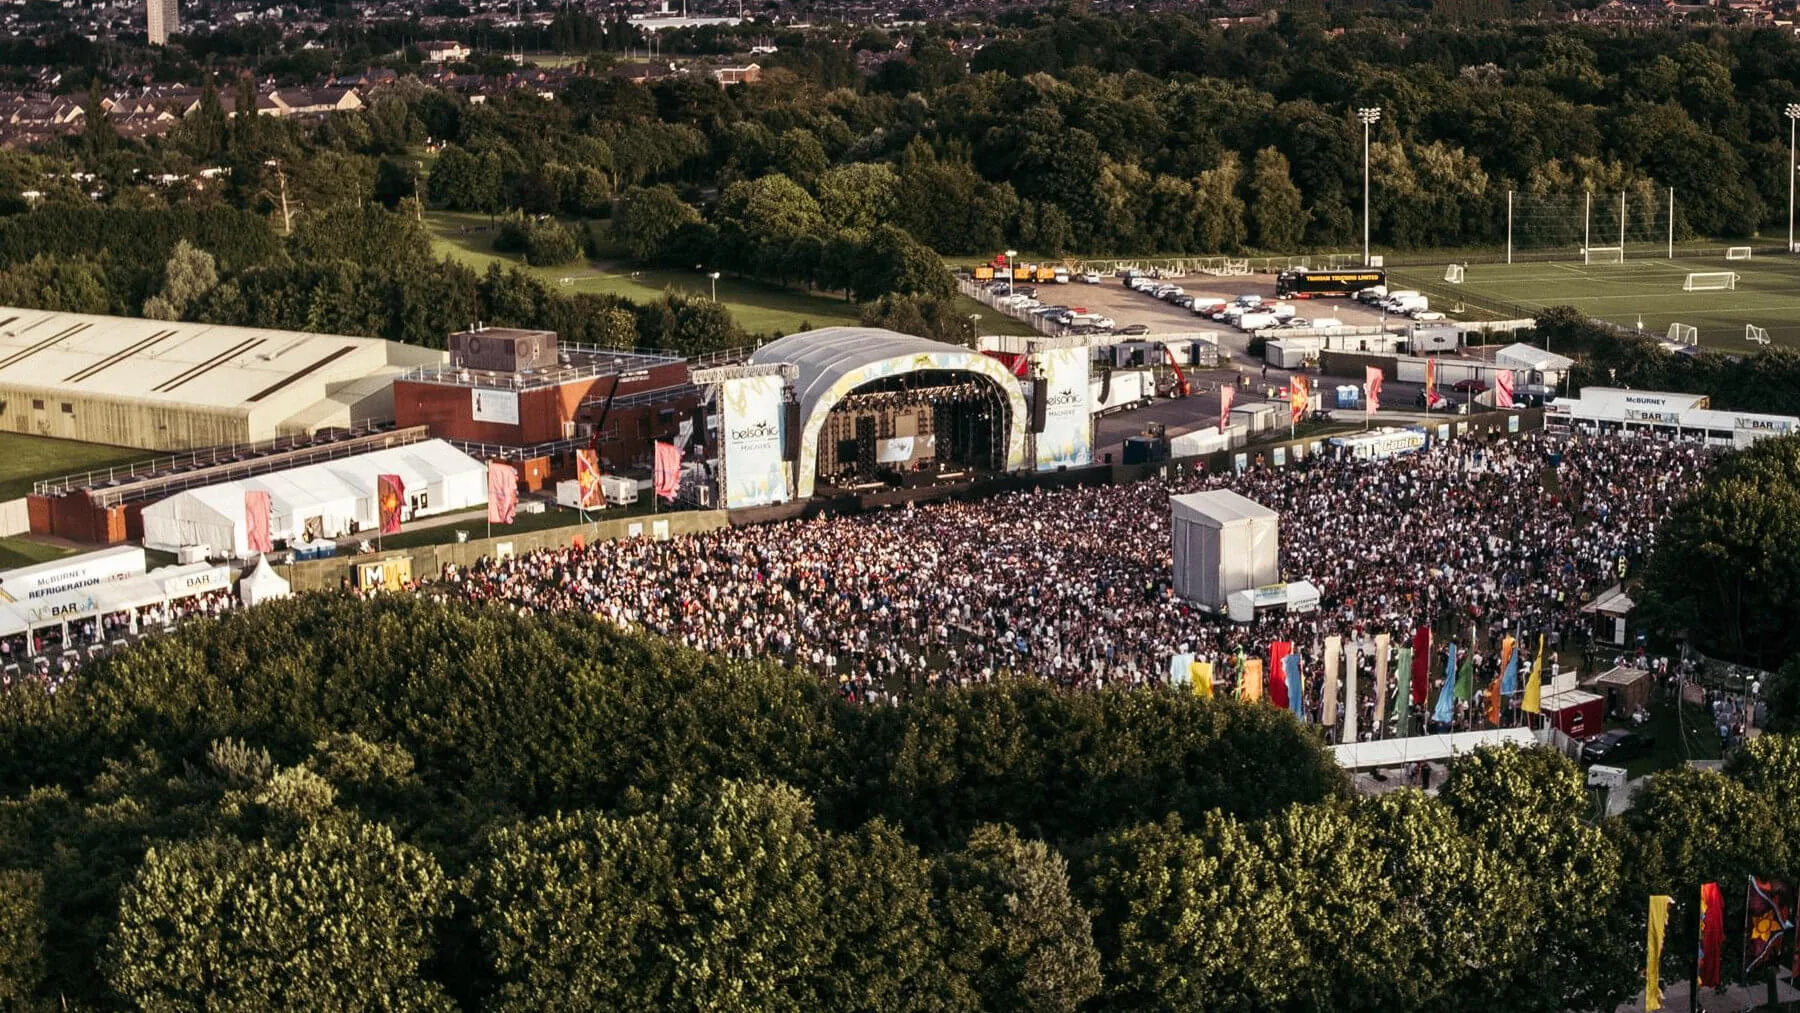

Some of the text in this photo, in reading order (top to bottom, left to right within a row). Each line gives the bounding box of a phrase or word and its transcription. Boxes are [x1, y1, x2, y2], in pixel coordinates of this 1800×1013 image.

[1047, 394, 1081, 406] elsonic
[1626, 397, 1666, 406] McBURNEY
[1641, 412, 1662, 420] BAR
[1752, 420, 1773, 429] BAR
[732, 426, 778, 441] belsonic
[37, 568, 86, 586] McBURNEY
[186, 575, 210, 587] BAR
[28, 577, 100, 600] REFRIGERATION
[51, 603, 77, 616] BAR
